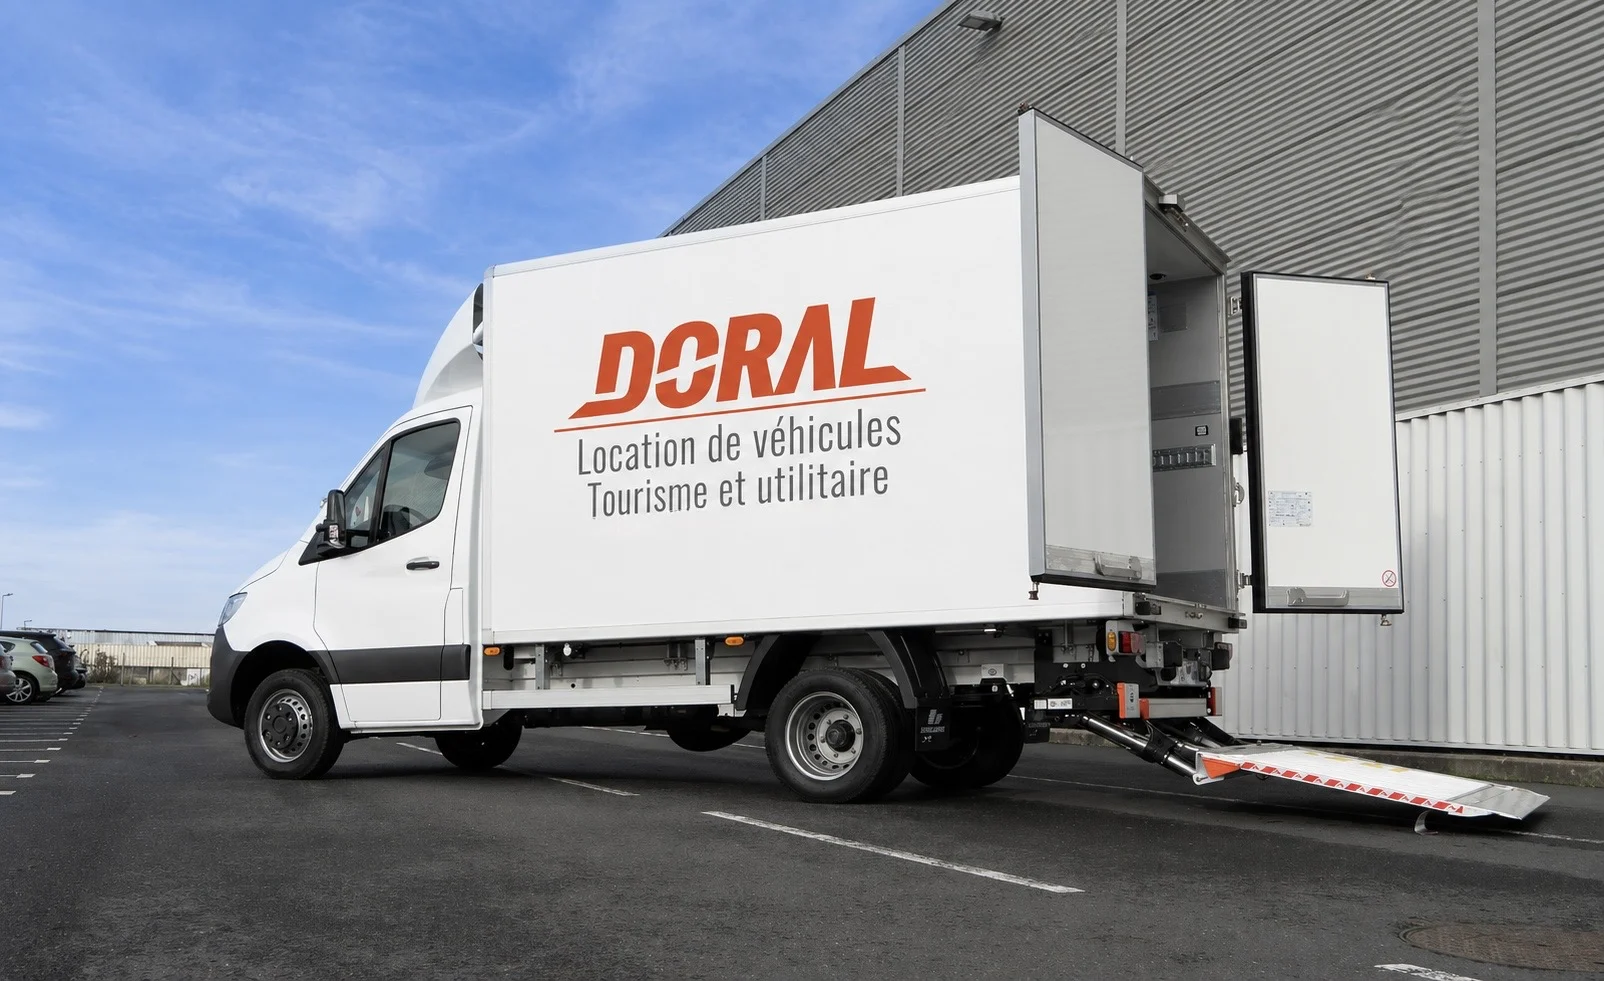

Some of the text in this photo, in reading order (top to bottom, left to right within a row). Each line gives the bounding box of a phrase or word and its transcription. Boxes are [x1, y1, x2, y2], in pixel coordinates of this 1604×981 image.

[569, 297, 911, 419] DORAL
[578, 408, 902, 476] Location de véhicules
[587, 460, 888, 519] Tourisme et utilitaire
